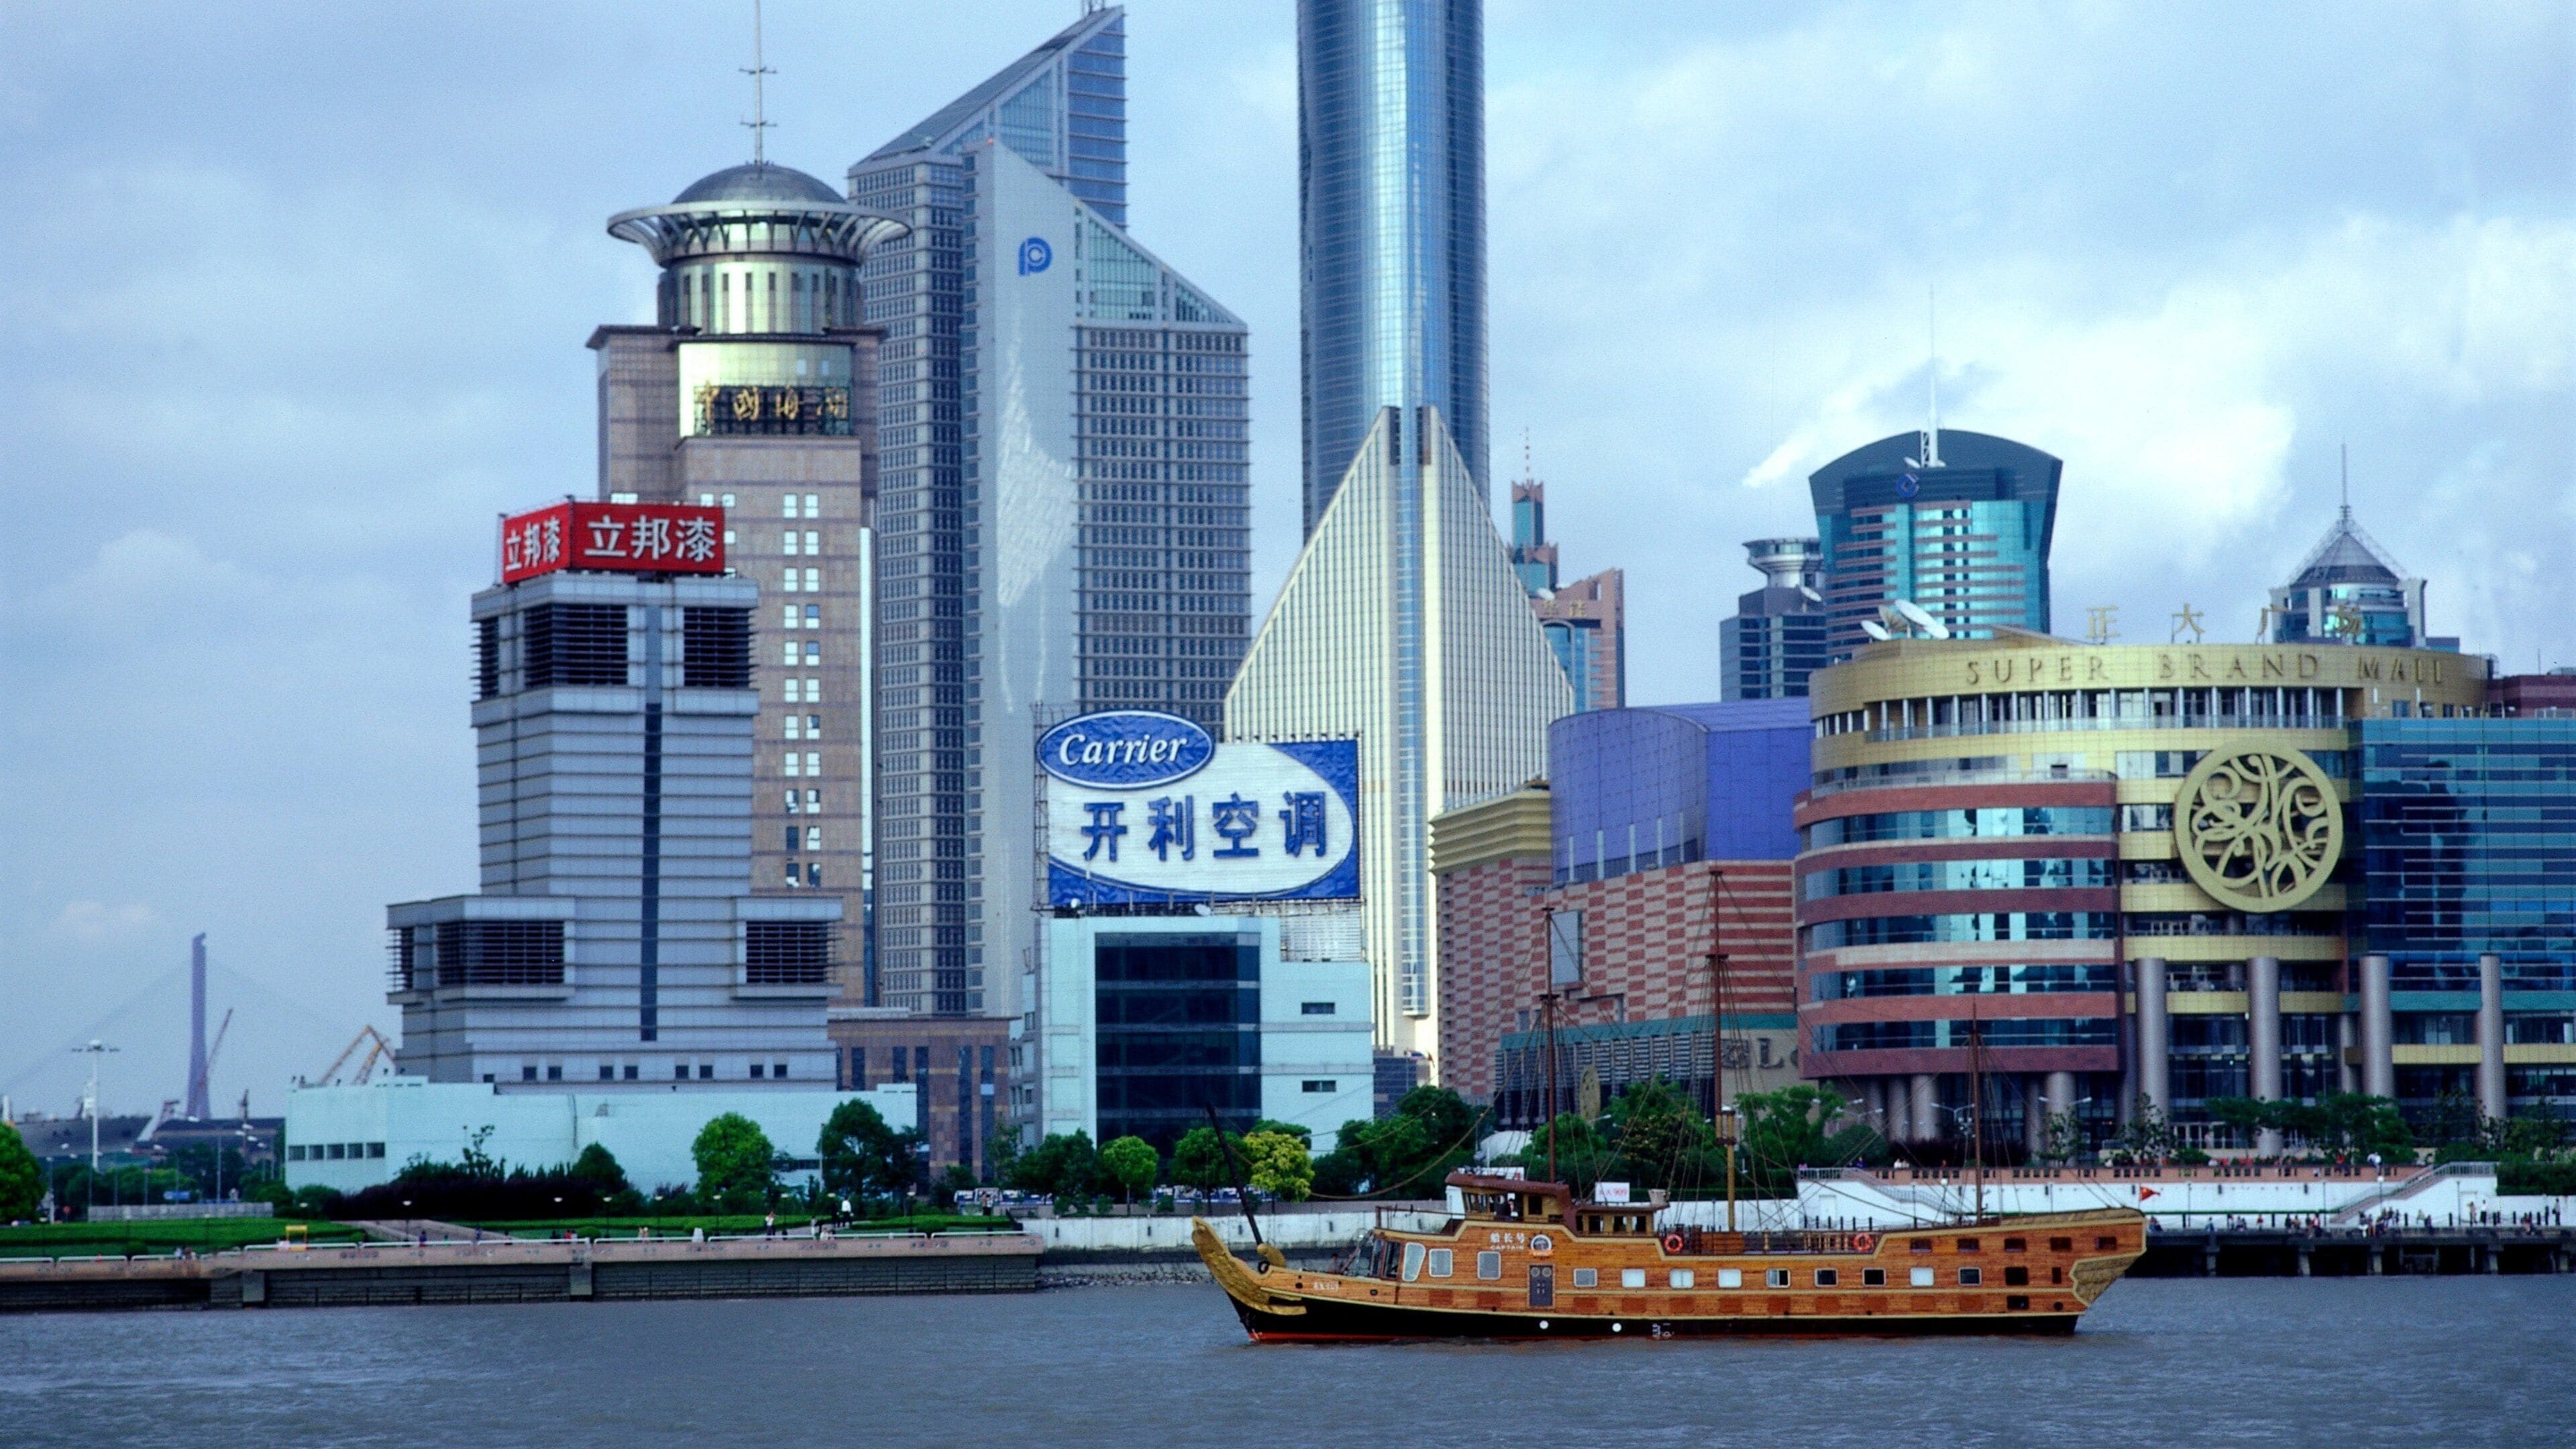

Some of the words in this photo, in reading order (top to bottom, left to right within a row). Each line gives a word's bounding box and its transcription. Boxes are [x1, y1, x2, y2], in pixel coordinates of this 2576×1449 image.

[505, 516, 561, 572] 立邦漆
[584, 515, 716, 562] 立邦漆
[1966, 655, 2109, 686] SUPER
[2159, 653, 2318, 680] BRAND
[2357, 655, 2443, 684] MALL
[1059, 734, 1189, 766] Carrier
[1080, 790, 1327, 863] 开利空调
